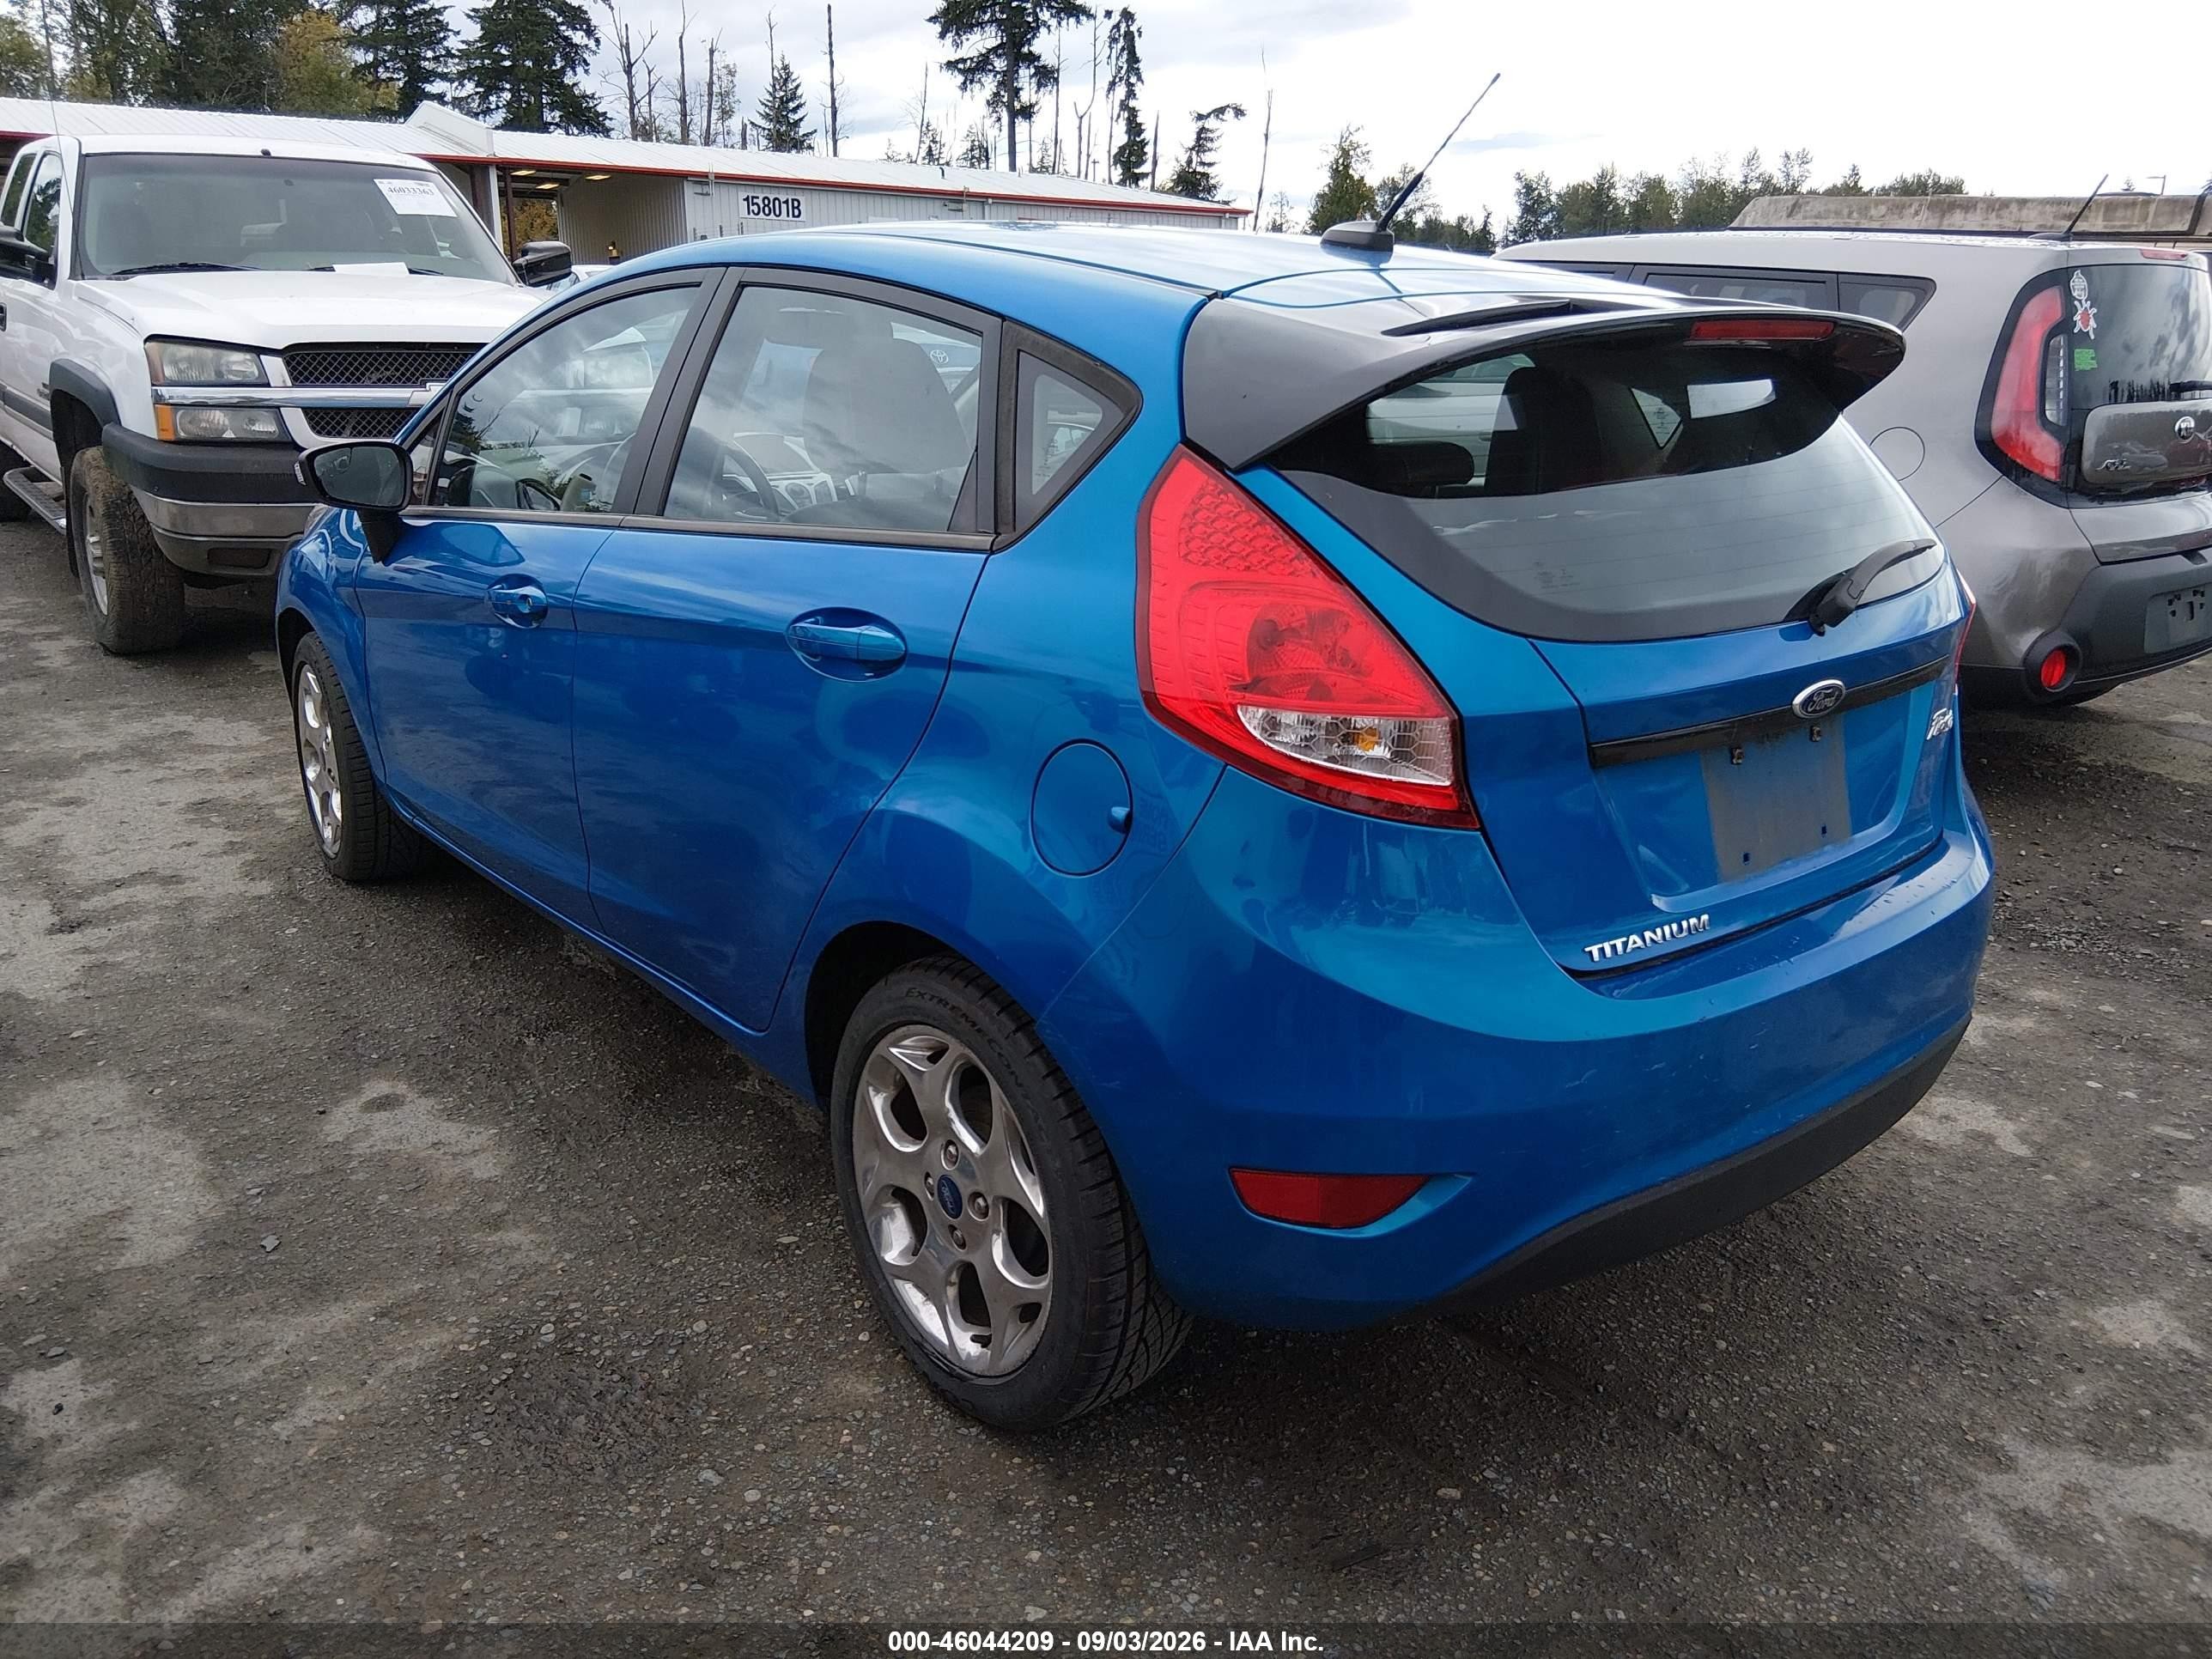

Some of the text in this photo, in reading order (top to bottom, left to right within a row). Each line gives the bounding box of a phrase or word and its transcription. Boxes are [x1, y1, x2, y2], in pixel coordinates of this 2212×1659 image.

[743, 195, 802, 218] 15801B
[1806, 686, 1839, 713] Ford
[1584, 914, 1711, 962] TITANIUM
